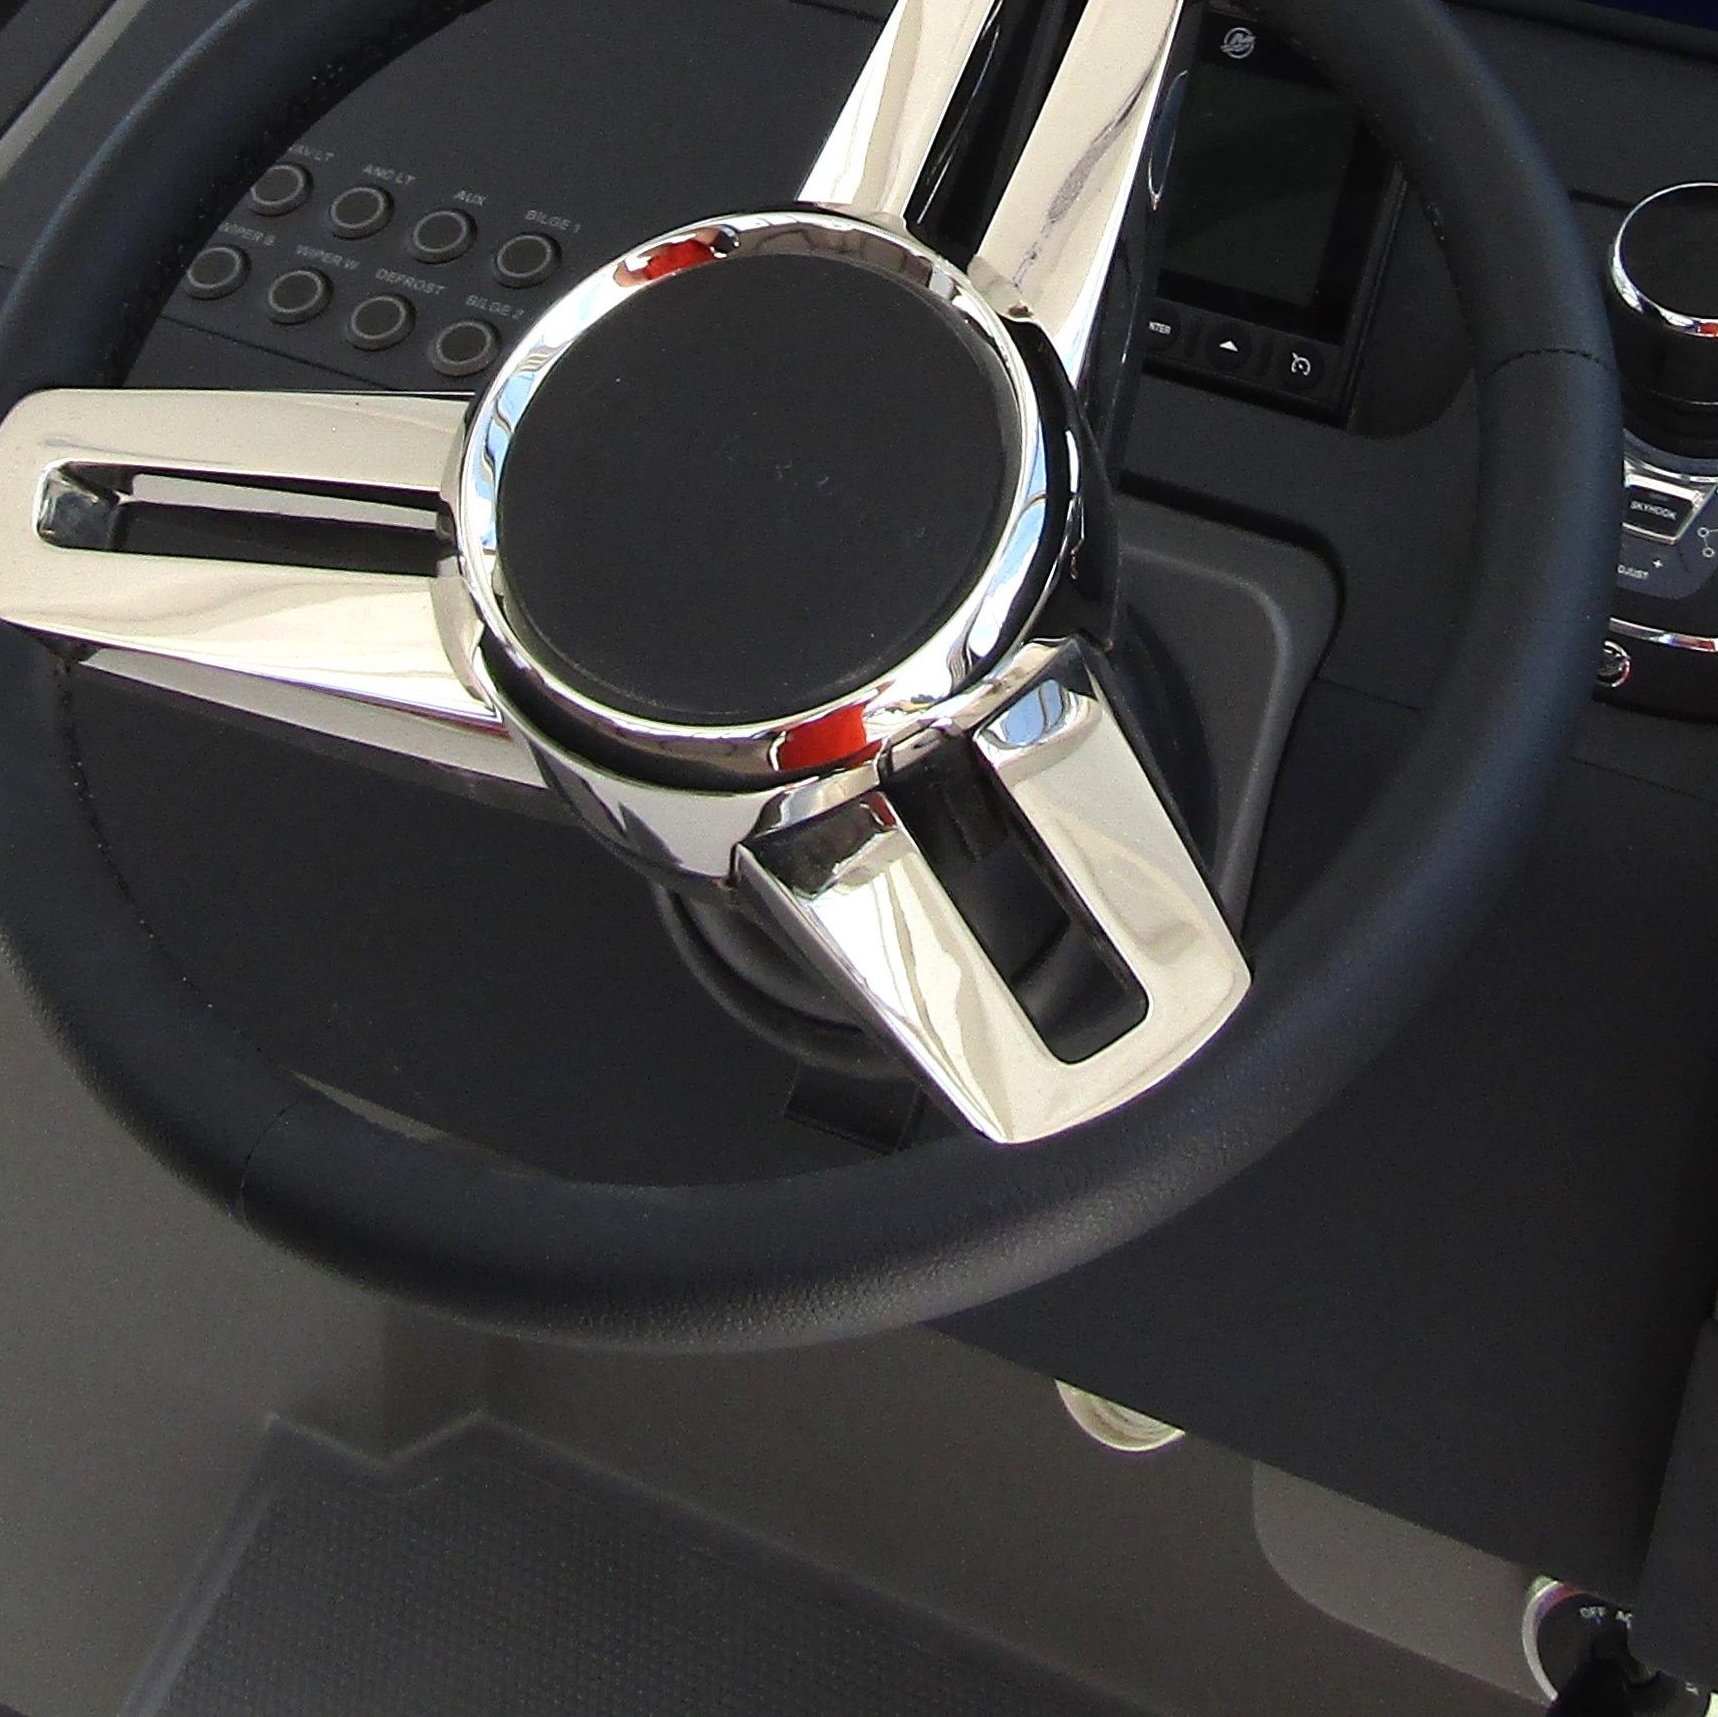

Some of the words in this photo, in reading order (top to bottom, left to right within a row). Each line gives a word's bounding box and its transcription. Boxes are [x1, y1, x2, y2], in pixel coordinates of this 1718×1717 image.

[453, 189, 487, 207] AUX
[524, 208, 572, 231] BILGE
[295, 244, 343, 267] WIPER
[374, 267, 446, 296] DEFROST
[464, 293, 512, 317] BILGE
[1629, 500, 1677, 521] SKYHOOK
[1617, 564, 1649, 580] DJUST
